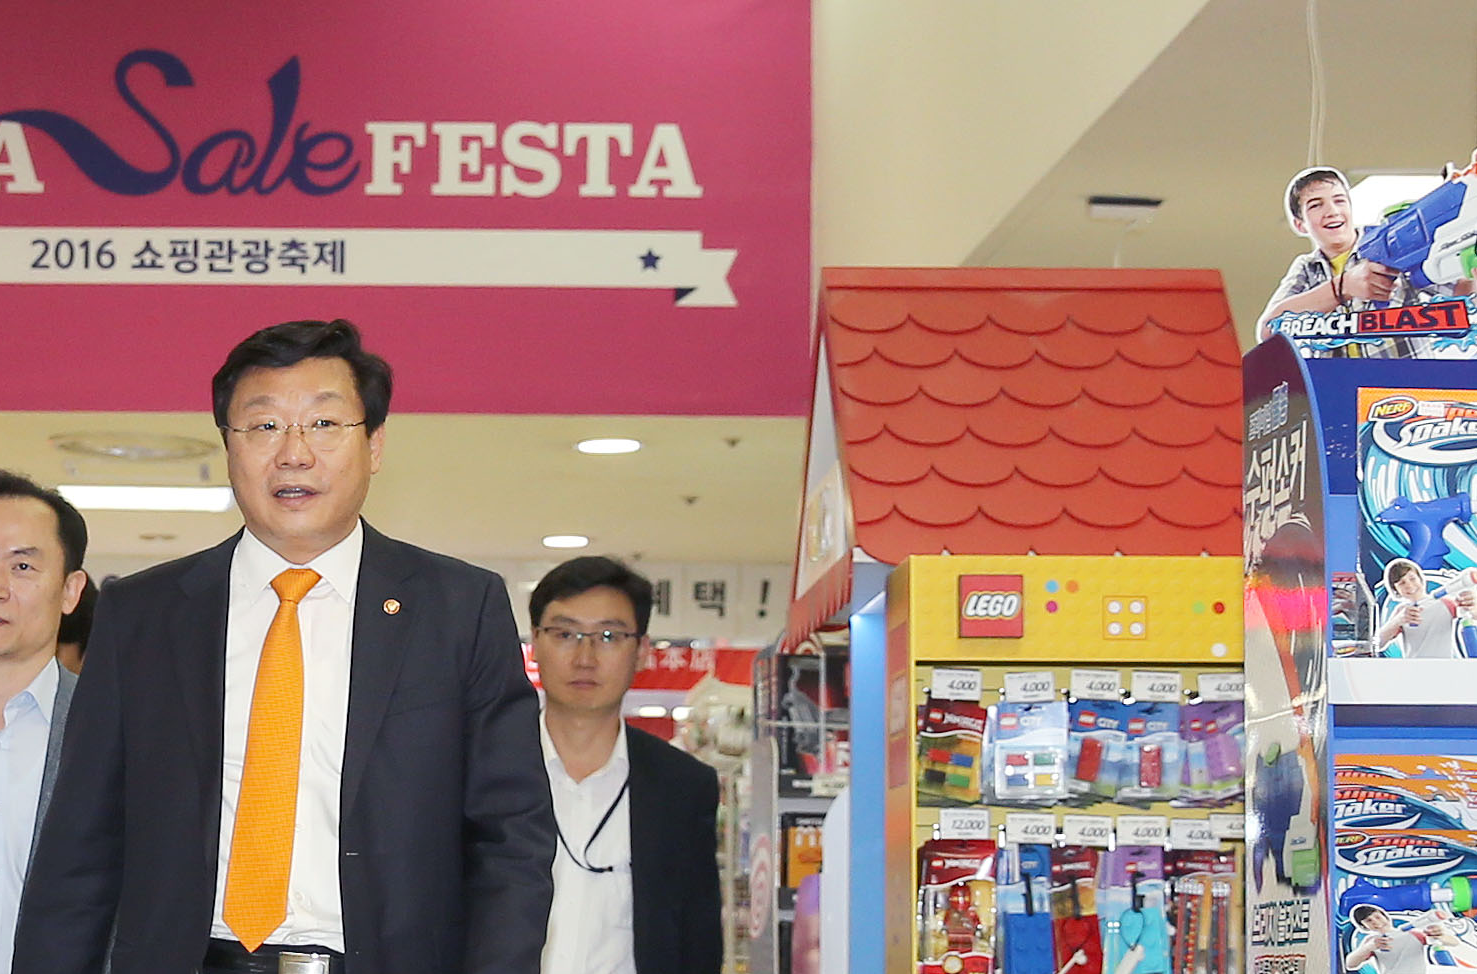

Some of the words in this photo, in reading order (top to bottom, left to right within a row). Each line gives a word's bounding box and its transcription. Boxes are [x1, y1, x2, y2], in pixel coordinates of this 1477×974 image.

[364, 121, 703, 198] FESTA
[29, 237, 117, 271] 2016
[130, 236, 347, 275] 쇼핑관광축제
[1280, 313, 1359, 337] BREACH
[1361, 303, 1461, 331] BLAST
[1373, 403, 1412, 418] NERF
[964, 593, 1020, 618] LEGO
[1354, 844, 1450, 868] Soaker
